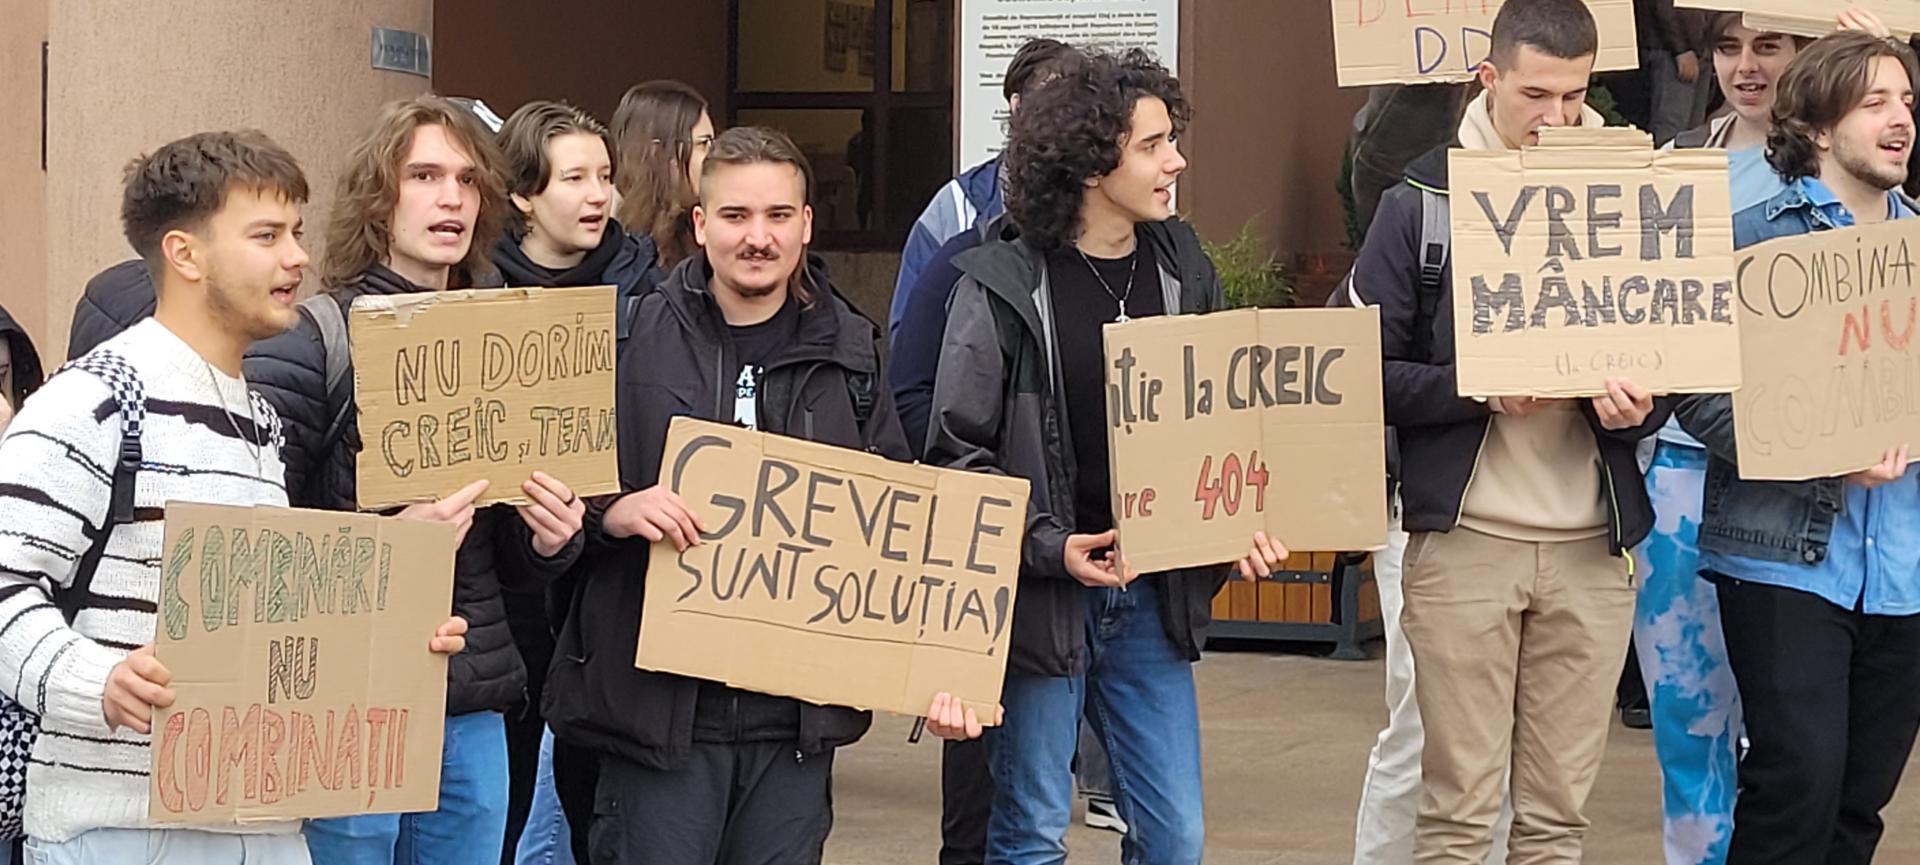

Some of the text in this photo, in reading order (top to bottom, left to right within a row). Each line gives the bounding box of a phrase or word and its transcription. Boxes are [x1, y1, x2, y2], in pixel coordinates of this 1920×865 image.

[1470, 184, 1696, 262] VREM
[1470, 257, 1734, 337] MÂNCARE
[1737, 236, 1917, 319] COMBINA
[395, 312, 613, 405] NU DORIM
[1838, 296, 1918, 356] NU
[1183, 345, 1213, 420] la
[1226, 345, 1346, 410] CREIC
[382, 397, 508, 478] CREIC
[671, 434, 1013, 574] GREVELE
[1194, 450, 1270, 520] 404
[165, 525, 392, 641] COMBINĂRI
[676, 541, 815, 603] SUNT
[268, 635, 319, 704] NU
[157, 703, 410, 813] COMBINAȚII
